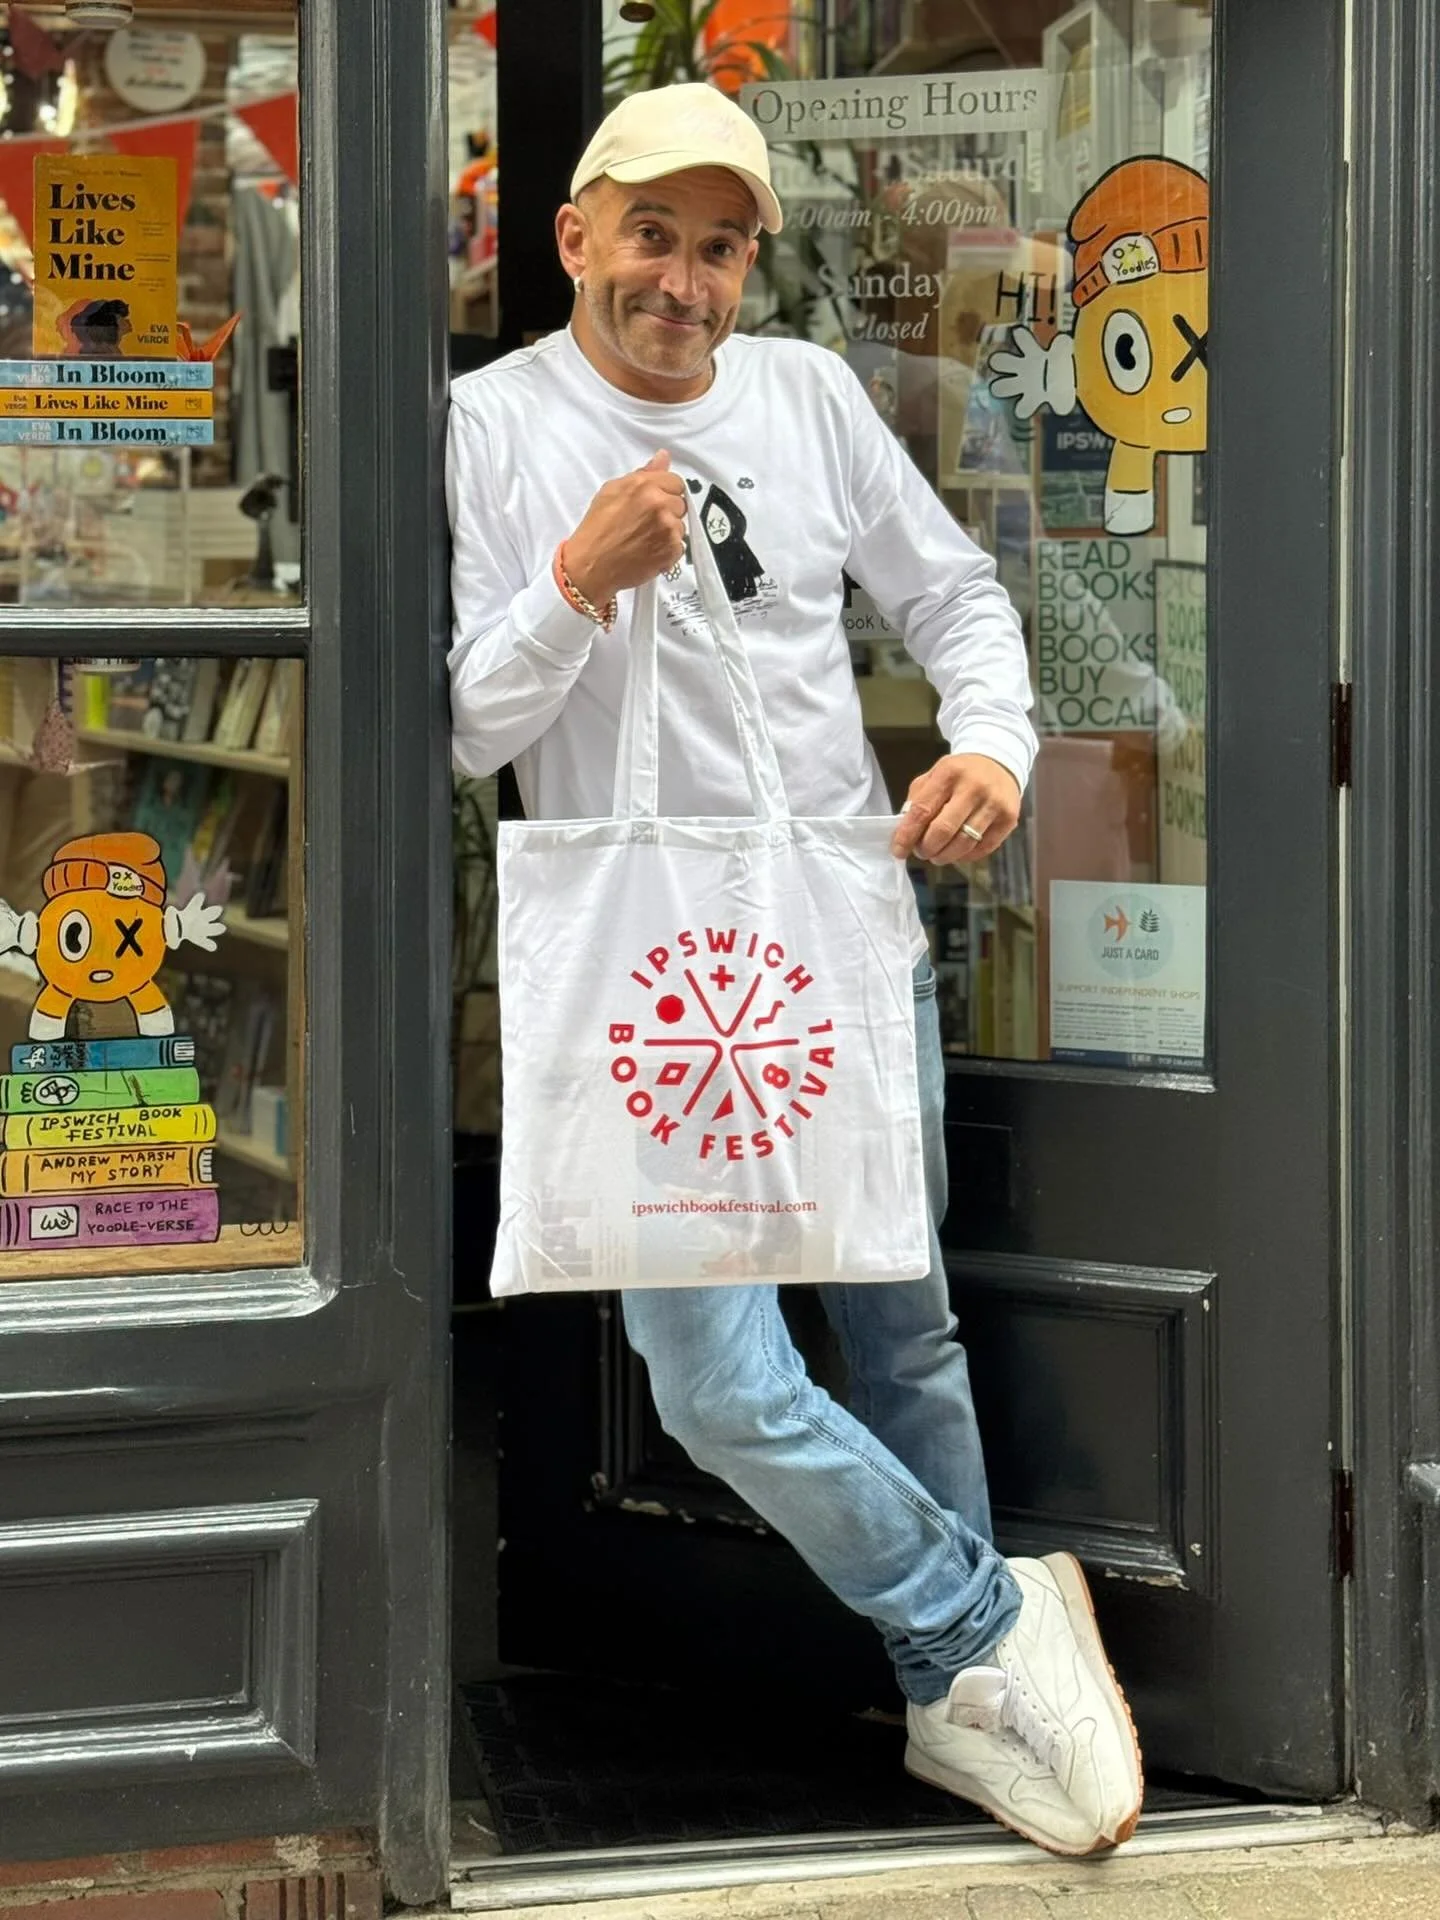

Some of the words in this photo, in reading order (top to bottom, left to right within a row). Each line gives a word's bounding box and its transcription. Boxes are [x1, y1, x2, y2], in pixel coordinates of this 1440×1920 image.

[752, 88, 909, 134] Opening
[923, 80, 1037, 118] Hours
[49, 183, 136, 212] Lives
[901, 199, 998, 231] 4:00pm
[49, 218, 125, 246] Like
[48, 253, 135, 281] Mine
[1112, 256, 1157, 277] Yoodles
[137, 334, 170, 345] VERDE
[149, 324, 170, 334] EVA
[56, 363, 82, 384] In
[90, 363, 166, 384] Bloom
[35, 394, 78, 410] Lives
[83, 394, 120, 410] Like
[126, 394, 169, 410] Mine
[56, 421, 82, 441] In
[90, 421, 167, 441] Bloom
[1037, 540, 1131, 570] READ
[1038, 571, 1157, 601] BOOKS
[1038, 603, 1106, 632] BUY
[1038, 633, 1157, 664] BOOKS
[1038, 665, 1107, 695] BUY
[631, 927, 814, 993] IPSWICH
[1101, 947, 1124, 960] JUST
[1125, 949, 1134, 960] A
[1134, 948, 1160, 961] CARD
[608, 1022, 680, 1145] BOOK
[698, 1019, 836, 1162] FESTIVAL
[40, 1112, 120, 1131] IPSWICH
[139, 1107, 182, 1122] BOOK
[66, 1123, 158, 1142] FESTIVAL
[41, 1156, 111, 1172] ANDREW
[120, 1151, 176, 1163] MARSH
[70, 1171, 96, 1184] MY
[108, 1164, 165, 1181] STORY
[95, 1202, 133, 1216] RACE
[137, 1201, 154, 1213] TO
[158, 1198, 190, 1213] THE
[631, 1198, 818, 1216] ipswichbookfestival.com
[88, 1218, 197, 1236] YOODLE-VERSE
